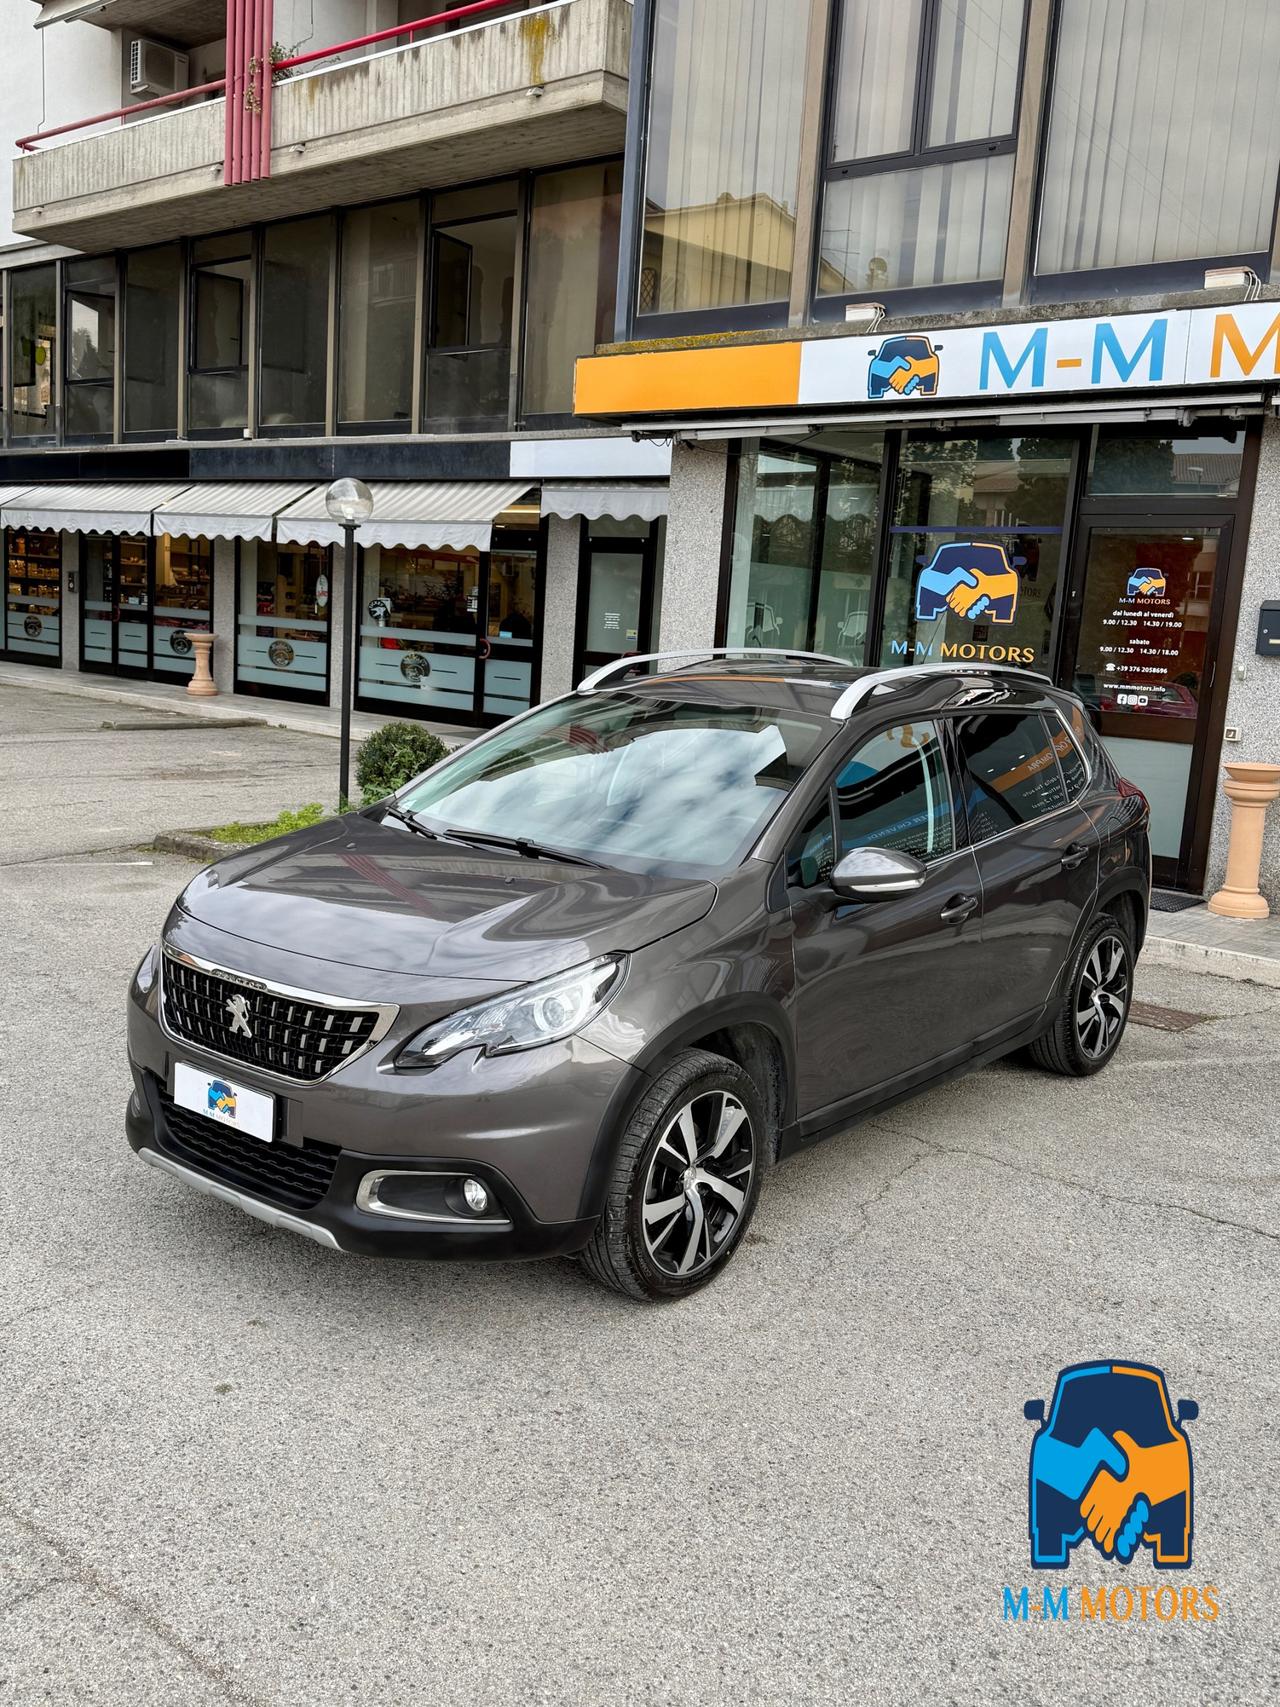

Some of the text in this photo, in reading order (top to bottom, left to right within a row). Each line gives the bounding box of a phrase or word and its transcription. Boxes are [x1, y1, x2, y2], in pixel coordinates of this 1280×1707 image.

[979, 318, 1168, 390] M-M
[891, 640, 1035, 663] M-M MOTORS
[1103, 683, 1166, 692] www.mmmotors.info
